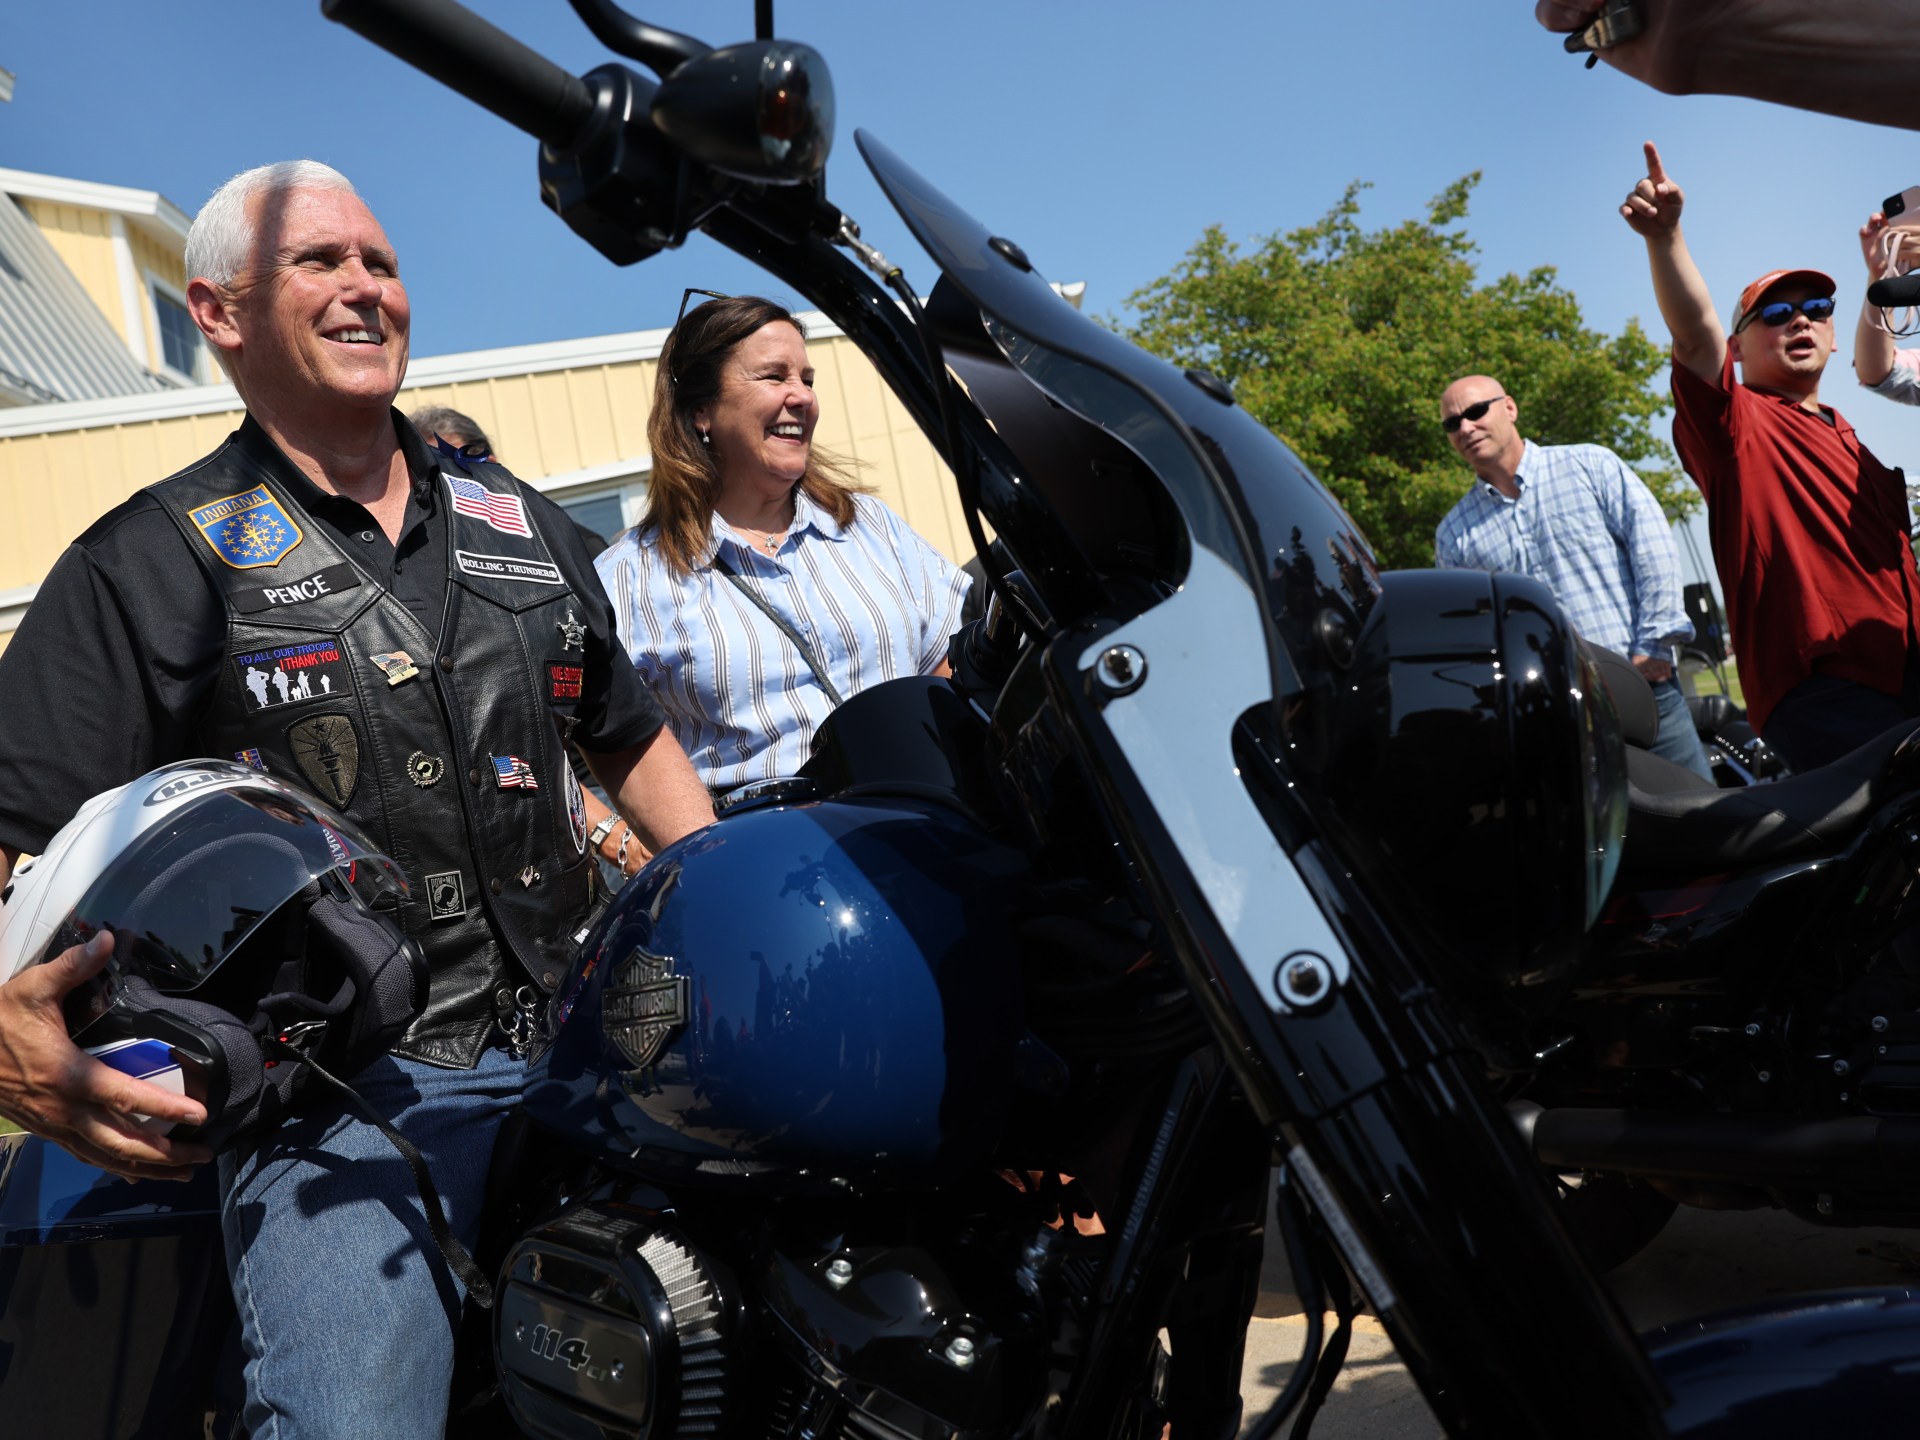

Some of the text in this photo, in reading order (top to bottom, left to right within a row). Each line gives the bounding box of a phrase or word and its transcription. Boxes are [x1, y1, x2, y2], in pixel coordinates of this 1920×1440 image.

[200, 493, 263, 522] INDIANA
[461, 558, 504, 571] ROLLING
[263, 575, 331, 604] PENCE
[237, 641, 335, 666] TO ALL OUR TROOPS
[279, 650, 340, 671] I THANK YOU
[606, 987, 678, 1020] LEY-DAVIDSON
[531, 1324, 591, 1371] 114
